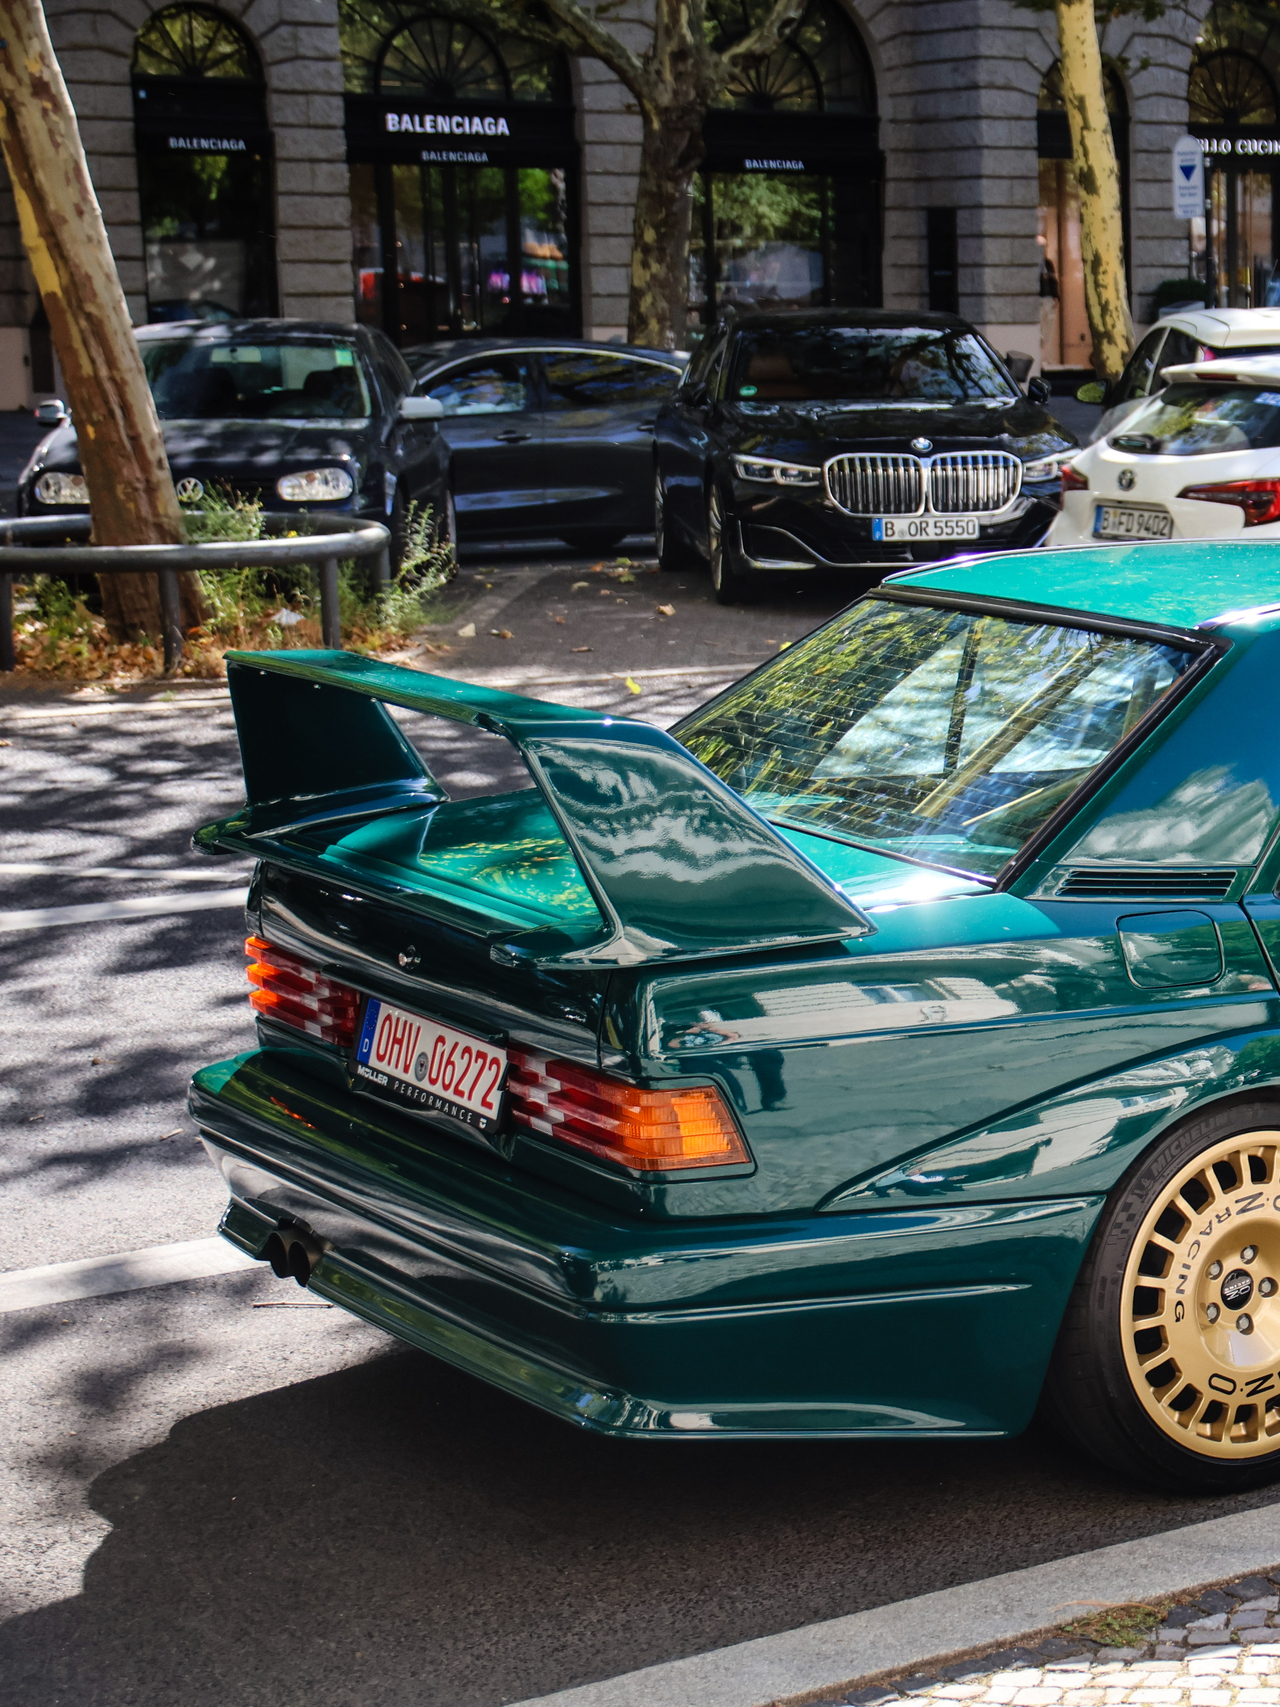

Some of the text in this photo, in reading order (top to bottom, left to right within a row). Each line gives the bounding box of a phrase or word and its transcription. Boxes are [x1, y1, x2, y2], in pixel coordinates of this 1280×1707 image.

[386, 112, 510, 137] BALENCIAGA
[169, 136, 247, 151] BALENCIAGA
[421, 150, 489, 164] BALENCIAGA
[745, 158, 805, 170] BALENCIAGA
[884, 519, 976, 538] B OR 5550
[1102, 510, 1168, 537] B FD 9402
[362, 1038, 370, 1053] D
[376, 1013, 502, 1110] OHV 06272
[394, 1080, 473, 1124] PERFORMANCE
[1174, 1205, 1233, 1324] RACING
